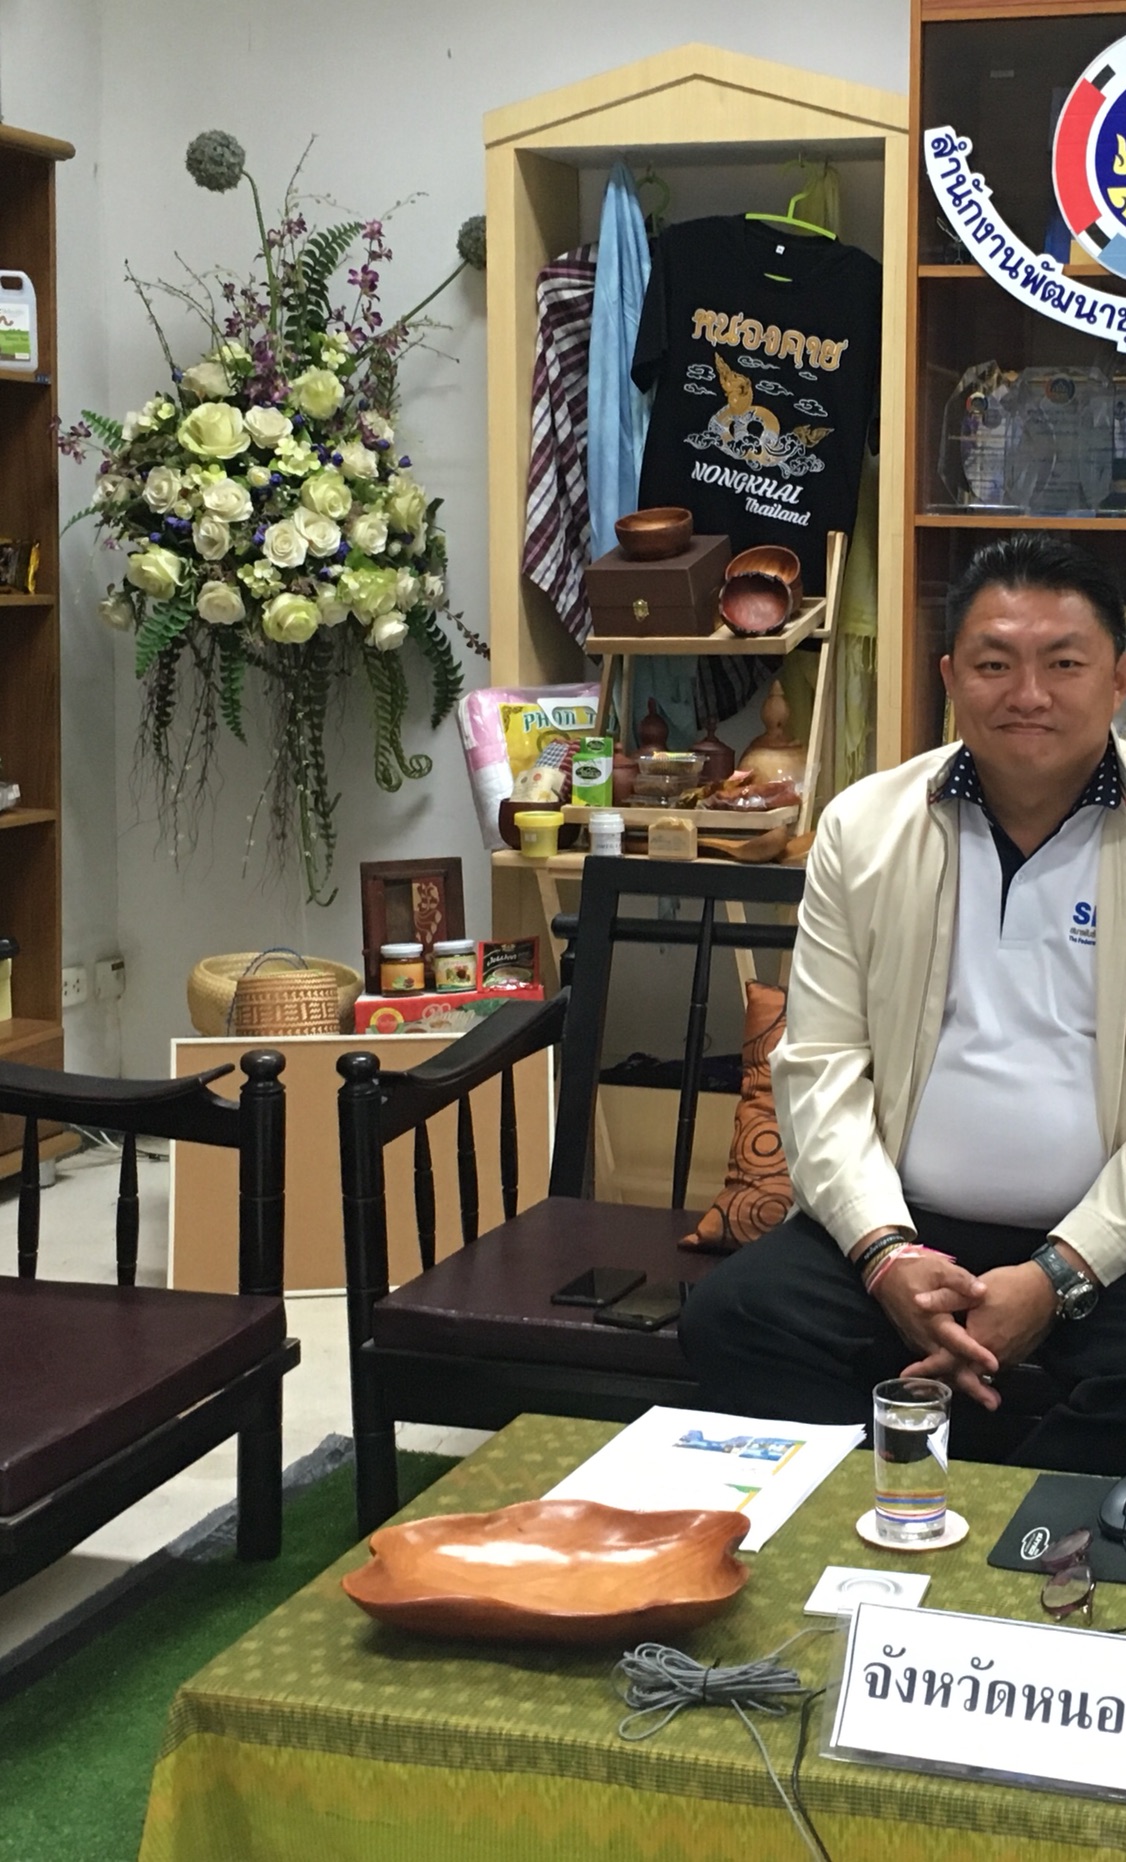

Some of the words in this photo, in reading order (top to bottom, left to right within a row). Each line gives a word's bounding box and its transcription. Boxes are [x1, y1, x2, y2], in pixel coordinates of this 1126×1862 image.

[691, 307, 849, 372] หนองคาย
[691, 461, 805, 506] NONGKHAI
[745, 496, 813, 527] Thailand
